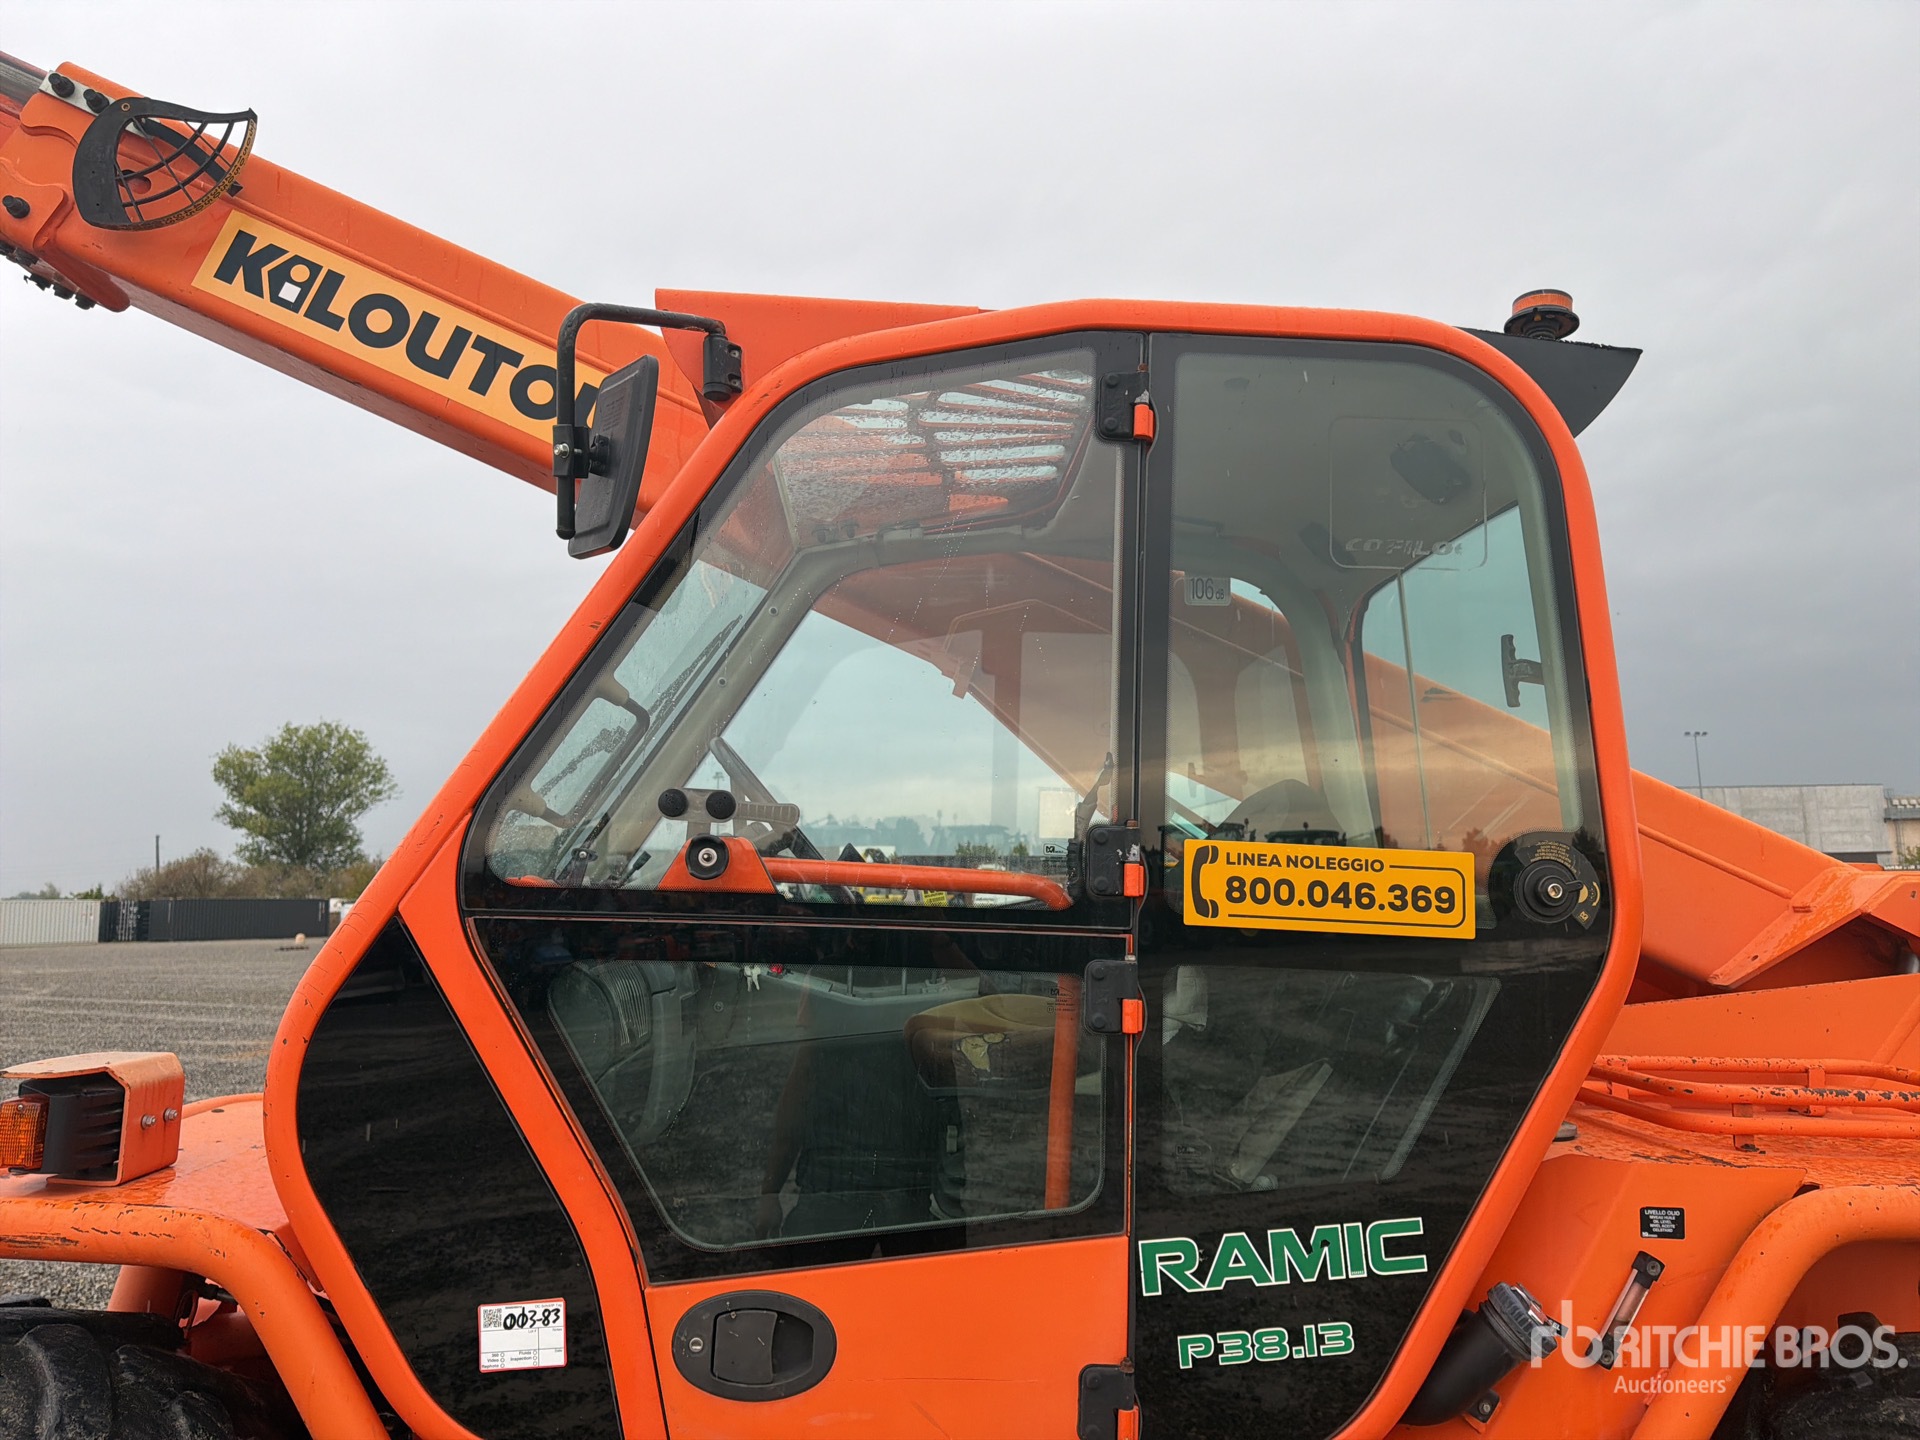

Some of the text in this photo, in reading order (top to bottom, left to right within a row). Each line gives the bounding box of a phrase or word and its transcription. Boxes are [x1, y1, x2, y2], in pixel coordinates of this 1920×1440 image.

[1190, 577, 1214, 600] 106
[1226, 852, 1385, 873] LINEA NOLEGGIO
[1225, 875, 1456, 914] 800.046.369
[1138, 1216, 1428, 1298] RAMIC
[1177, 1321, 1355, 1371] P38.13
